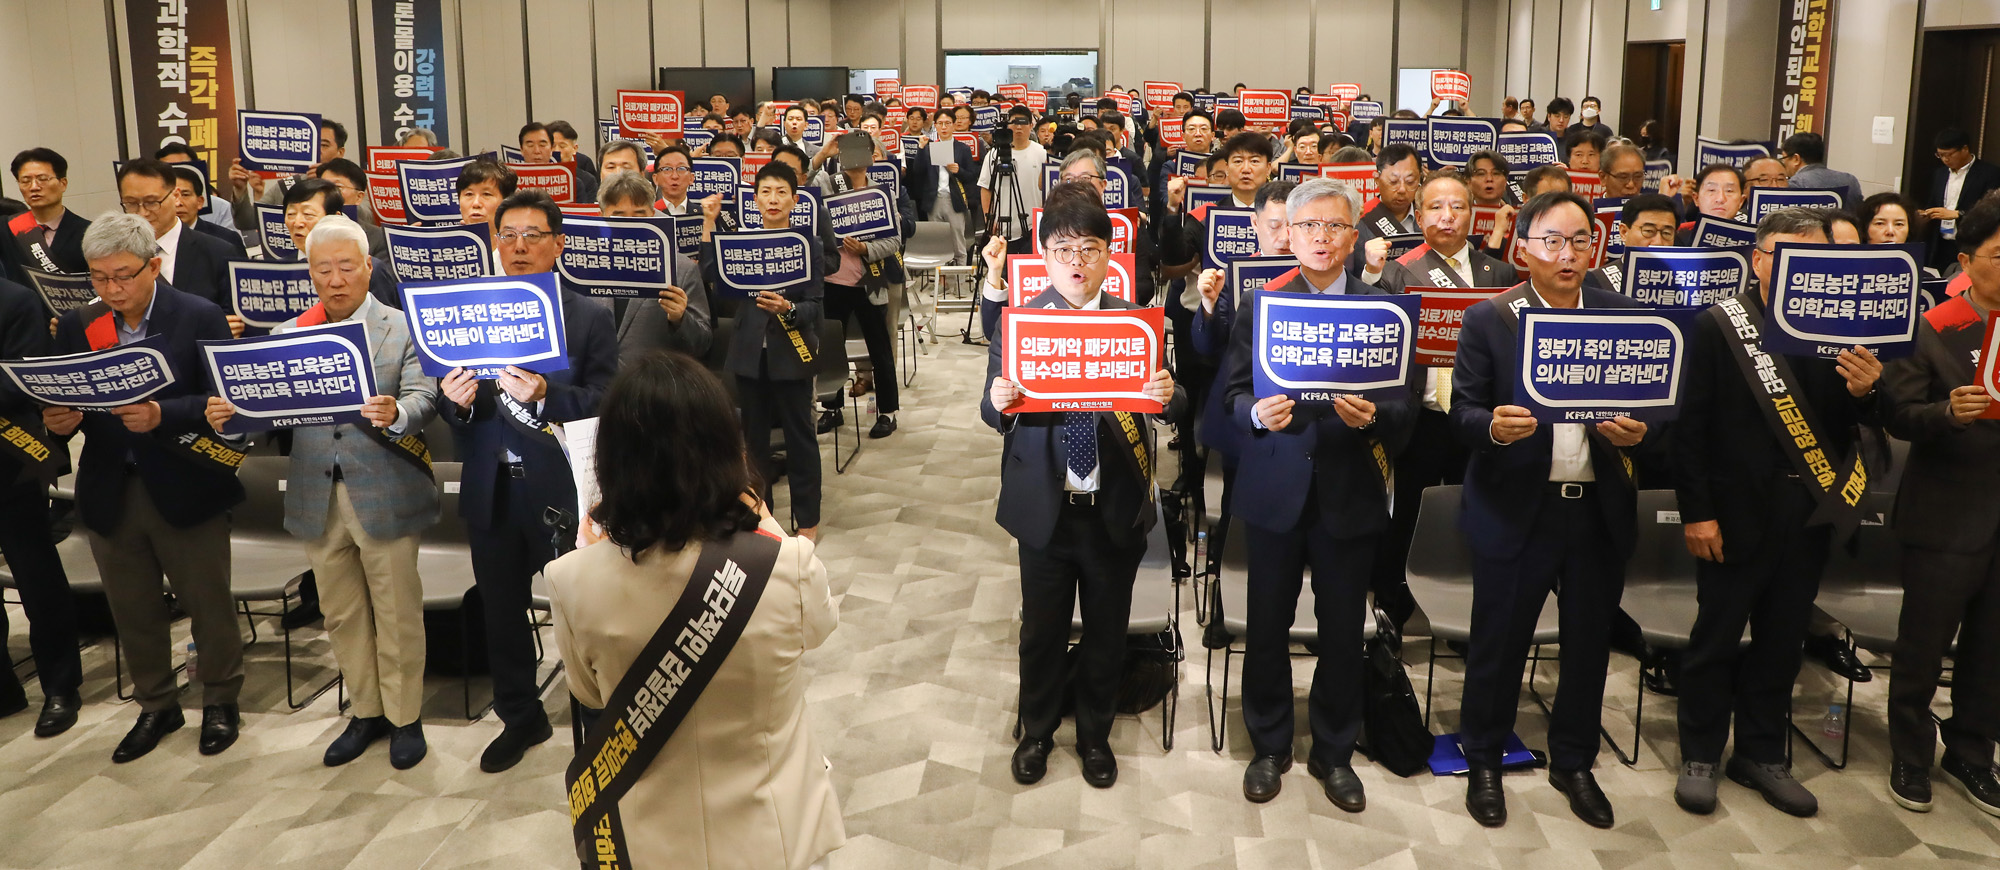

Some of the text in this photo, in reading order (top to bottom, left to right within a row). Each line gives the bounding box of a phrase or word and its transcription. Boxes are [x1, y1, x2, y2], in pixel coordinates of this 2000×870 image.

[189, 46, 219, 110] 즉각
[415, 48, 436, 101] 강력
[625, 102, 676, 112] 의료개악 패키지로
[650, 113, 677, 124] 붕괴된다
[247, 125, 312, 140] 의료농단 교육농단
[1433, 130, 1492, 143] 정부가 죽인 한국의료
[247, 138, 311, 153] 의학교육 무너진다
[1500, 143, 1554, 154] 의료농단 교육농단
[1529, 154, 1555, 164] 무너진다
[409, 178, 448, 193] 의료농단
[537, 175, 568, 186] 패키지로
[704, 171, 733, 183] 교육농단
[541, 185, 569, 196] 괴된다
[703, 182, 733, 194] 무너진다
[412, 193, 451, 207] 의학교육
[860, 197, 884, 212] 한국의료
[393, 244, 478, 263] 의료농단 교육농단
[564, 235, 660, 255] 의료농단 교육농단
[724, 243, 803, 261] 의료농단 교육농단
[1216, 240, 1256, 255] 의학교육
[396, 263, 481, 280] 의학교육 무너진다
[564, 253, 662, 273] 의학교육 무너진다
[726, 258, 804, 277] 의학교육 무너진다
[1637, 267, 1740, 287] 정부가 죽인 한국의료
[1790, 272, 1911, 295] 의료농단 교육농단
[240, 279, 285, 296] 의료농단
[240, 296, 287, 313] 의학교육
[1635, 288, 1690, 307] 의사들이
[420, 300, 542, 327] 정부가 죽인 한국의료
[1786, 297, 1908, 321] 의학교육 무너진다
[425, 321, 546, 348] 의사들이 살려낸다
[1271, 320, 1401, 345] 의료농단 교육농단
[1020, 336, 1146, 358] 의료개악 패키지로
[1270, 345, 1398, 368] 의학교육 무너진다
[1537, 338, 1671, 361] 정부가 죽인 한국의료
[22, 355, 154, 385] 의료농단 교육농단
[223, 352, 351, 382] 의료농단 교육농단
[1020, 360, 1146, 380] 필수의료 붕괴된다
[1535, 363, 1669, 385] 의사들이 살려낸다
[31, 368, 159, 397] 의학교육 무너진다
[230, 374, 356, 401] 의학교육 무너진다
[1052, 401, 1080, 409] KMA
[272, 418, 302, 427] KMA
[1565, 411, 1595, 420] KMA
[1771, 394, 1817, 450] 지금당장
[1, 424, 51, 462] 희망없다
[190, 436, 244, 468] 한국의료
[675, 558, 748, 664] 독단적인
[628, 650, 693, 739] 갑질정부
[592, 717, 638, 792] 한국의료
